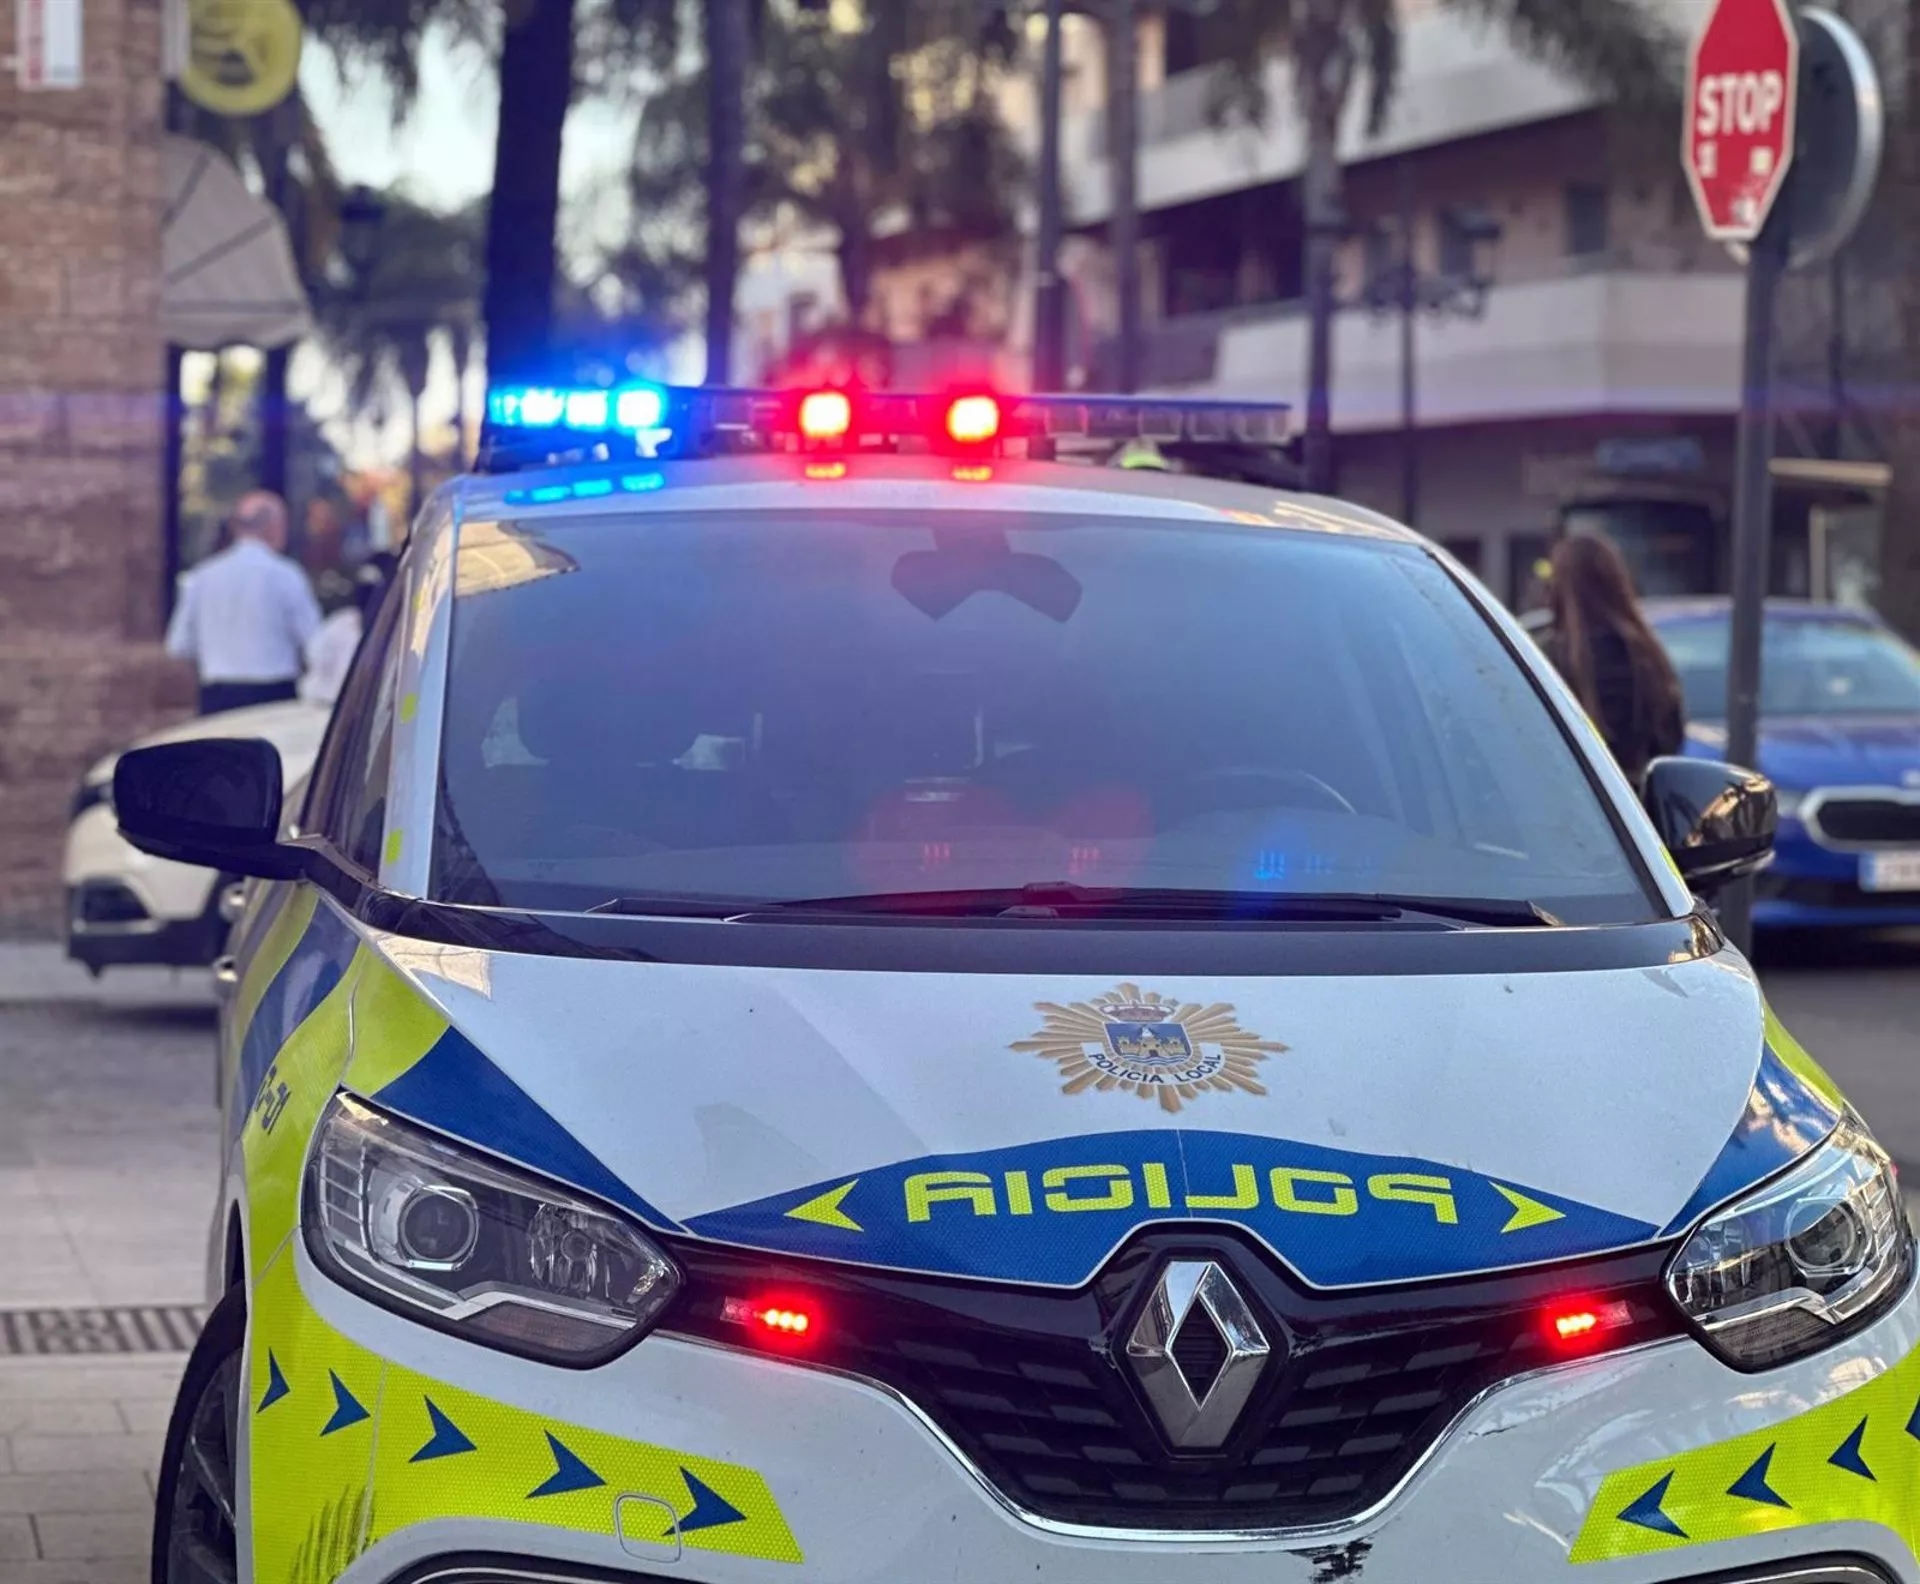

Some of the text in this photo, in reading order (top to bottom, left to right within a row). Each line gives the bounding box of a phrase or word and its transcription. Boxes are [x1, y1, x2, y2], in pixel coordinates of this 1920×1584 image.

[1697, 70, 1784, 136] STOP
[1088, 1052, 1222, 1084] POLICIA LOCAL
